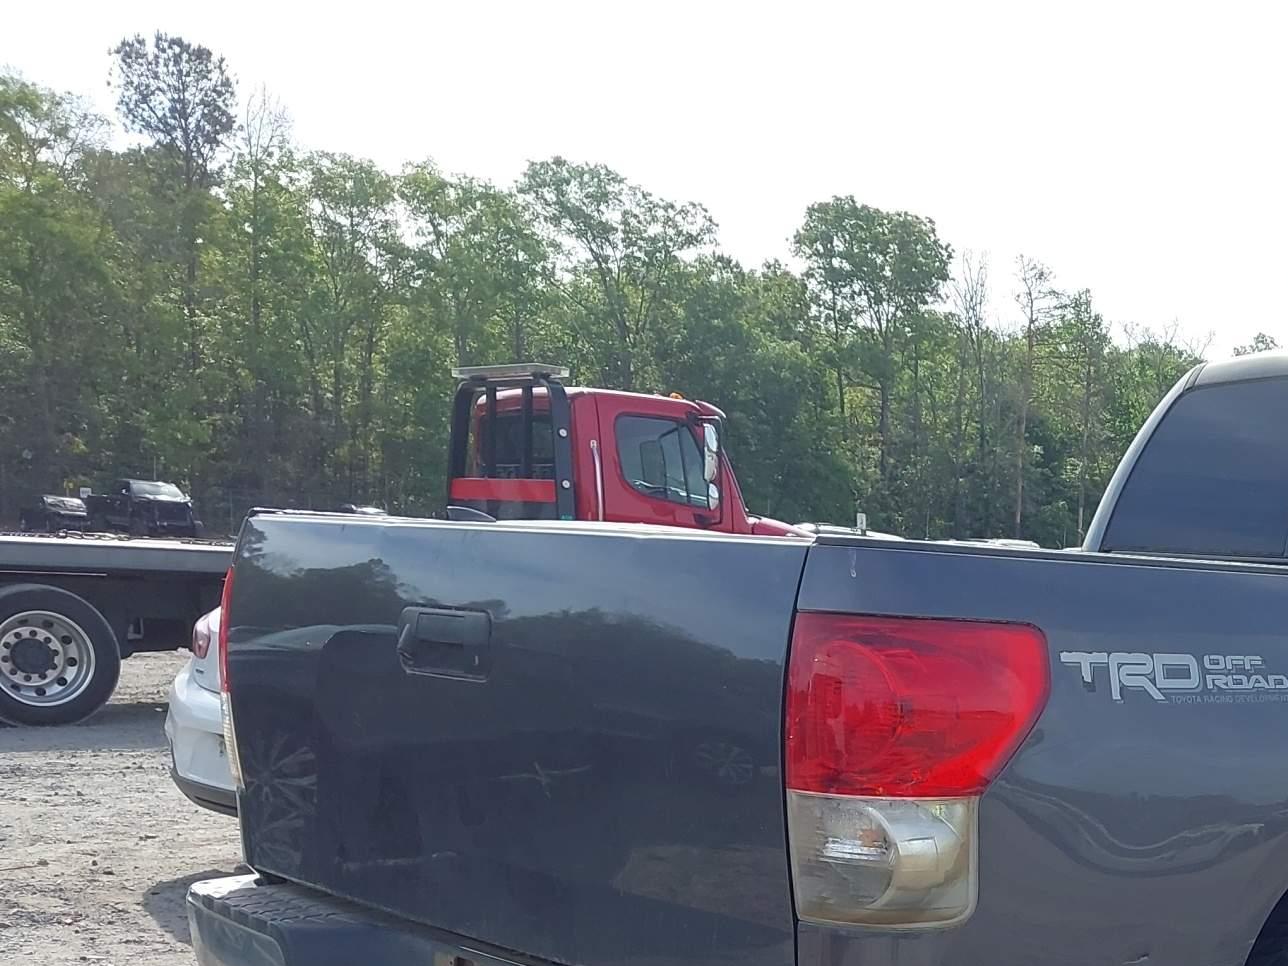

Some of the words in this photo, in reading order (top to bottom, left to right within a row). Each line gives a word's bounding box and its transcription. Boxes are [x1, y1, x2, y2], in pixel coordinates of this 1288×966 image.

[1203, 654, 1265, 671] OFF
[1059, 651, 1200, 702] TRD
[1171, 695, 1202, 704] TOYOTA
[1203, 695, 1233, 704] RACING
